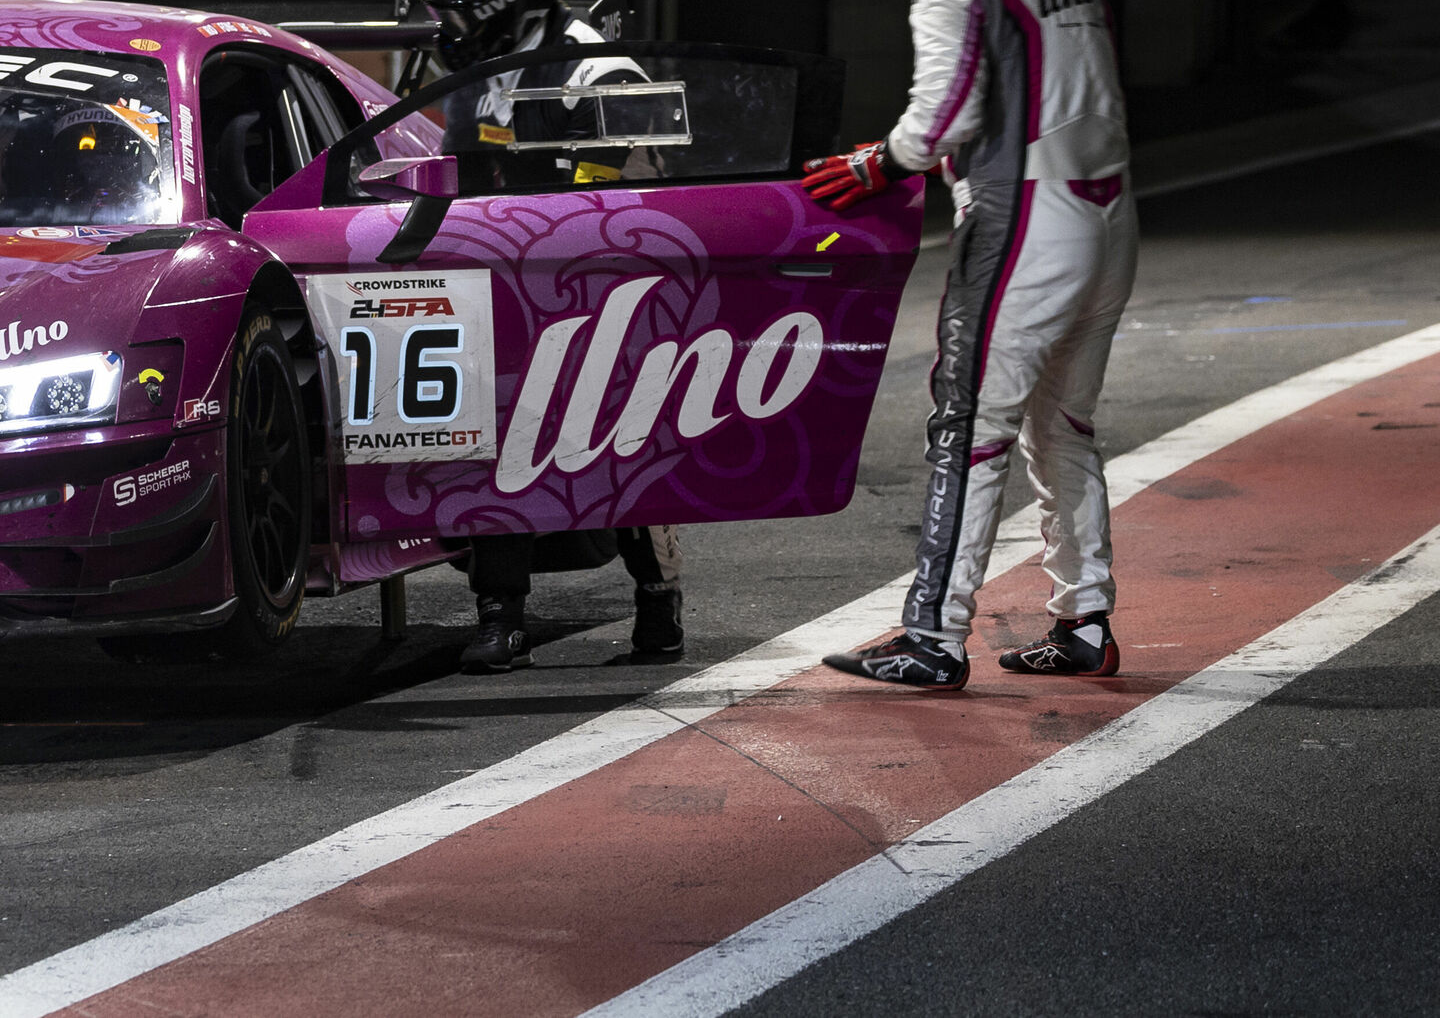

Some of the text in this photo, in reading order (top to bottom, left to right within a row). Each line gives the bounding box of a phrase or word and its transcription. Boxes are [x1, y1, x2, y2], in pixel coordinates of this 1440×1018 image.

[67, 109, 120, 123] HYUND
[354, 278, 447, 291] CROWDSTRIKE
[340, 323, 465, 426] 16
[494, 275, 825, 494] Uno
[192, 399, 221, 418] RS
[138, 459, 191, 486] SCHERER
[139, 470, 192, 497] SPORT PHX
